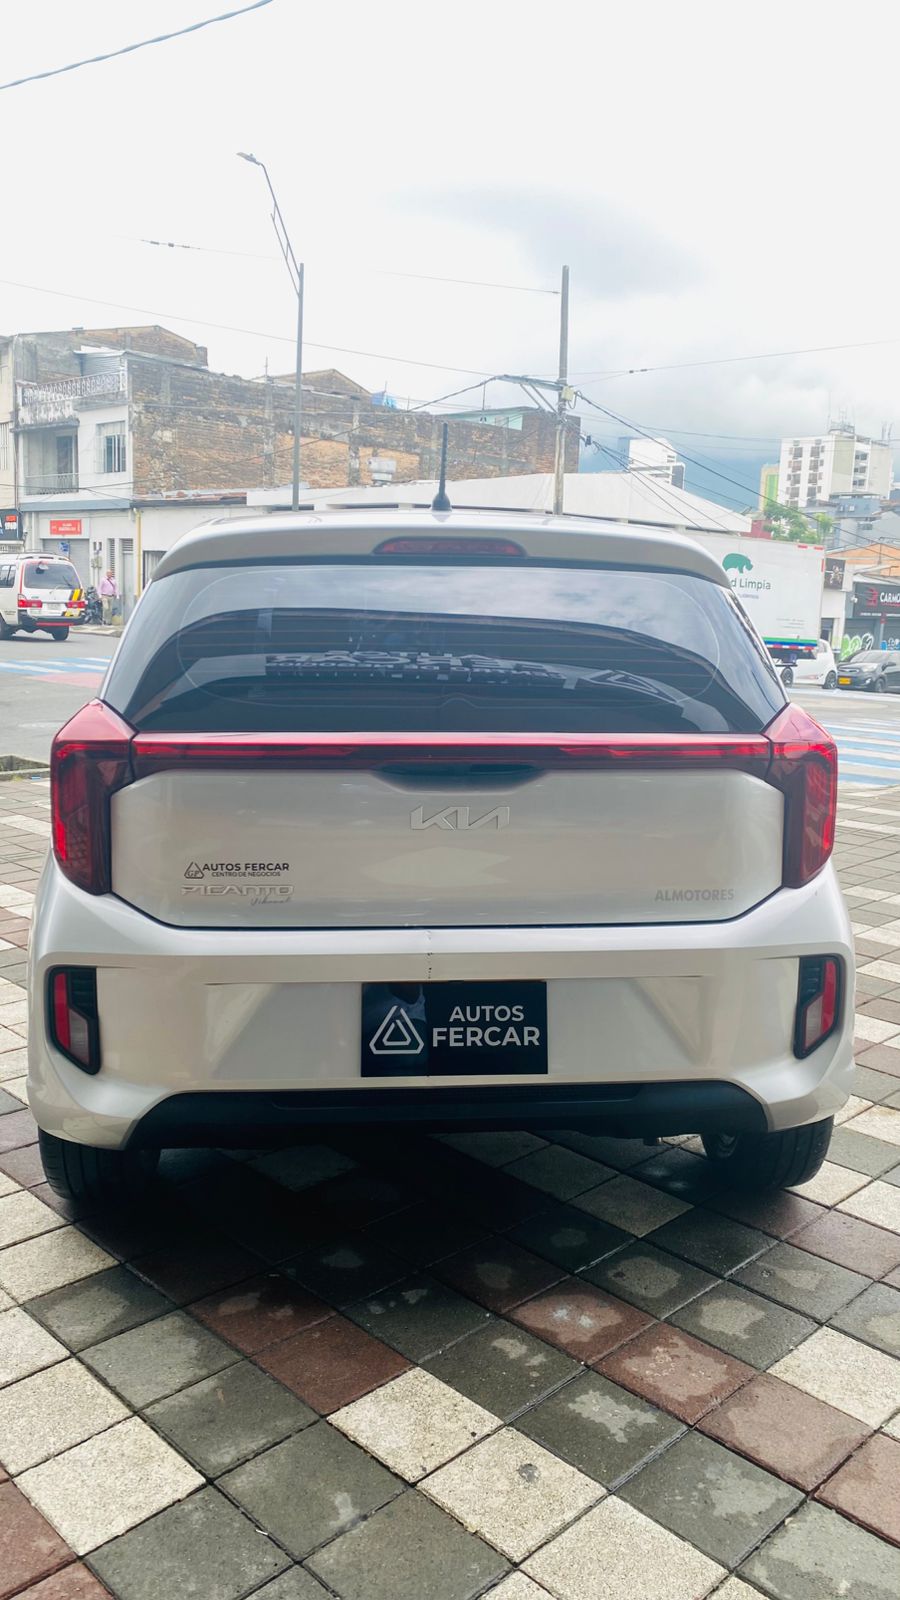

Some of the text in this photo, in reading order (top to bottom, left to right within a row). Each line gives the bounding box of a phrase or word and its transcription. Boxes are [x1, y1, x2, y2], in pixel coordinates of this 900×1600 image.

[739, 579, 772, 591] Limpia
[410, 806, 511, 830] KIA
[202, 863, 290, 871] AUTOS FERCAR
[181, 884, 295, 896] PICANTO
[654, 889, 735, 902] ALMOTORES
[449, 1005, 525, 1022] AUTOS
[432, 1026, 541, 1048] FERCAR
